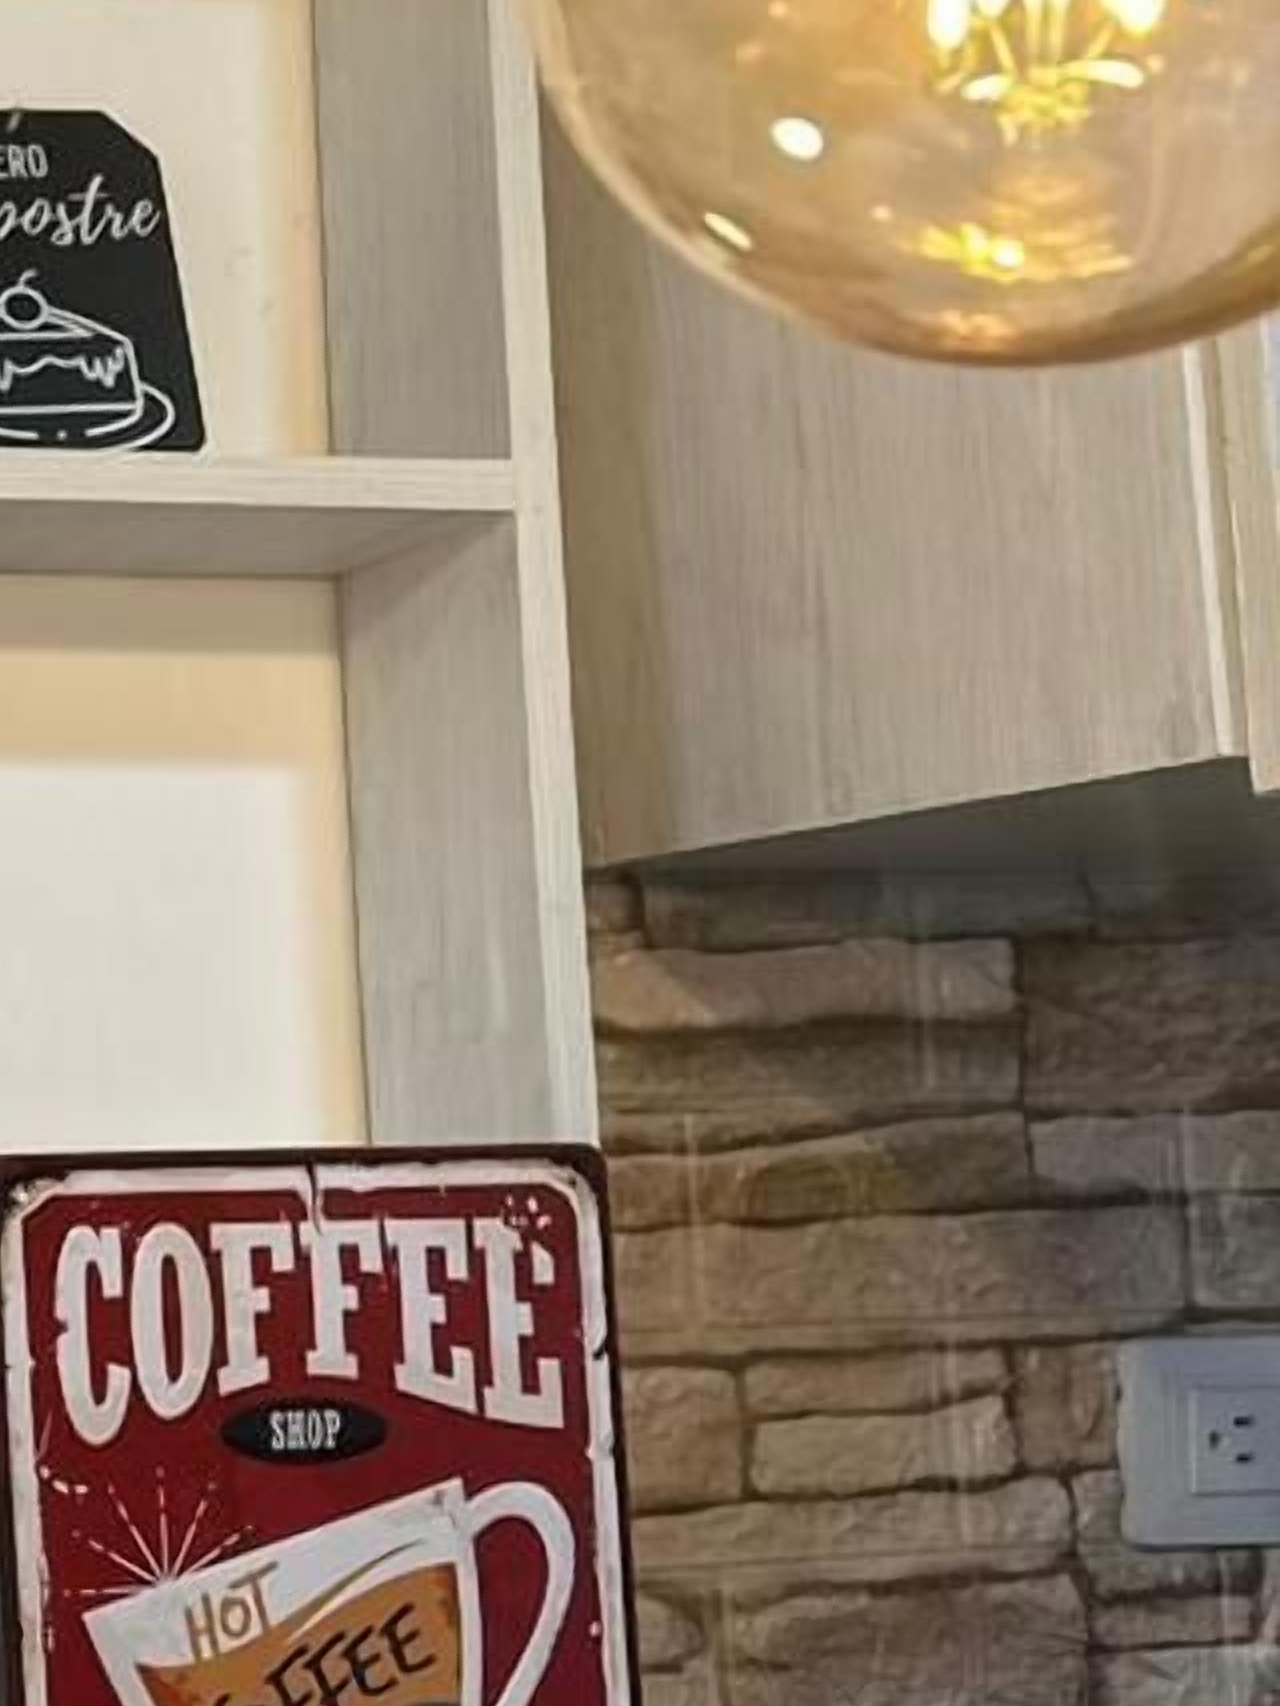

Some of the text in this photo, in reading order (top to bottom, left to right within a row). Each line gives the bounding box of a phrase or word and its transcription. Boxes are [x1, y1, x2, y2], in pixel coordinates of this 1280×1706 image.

[54, 1215, 565, 1445] COFFEE
[269, 1408, 343, 1451] SHOP
[184, 1561, 279, 1661] HOT
